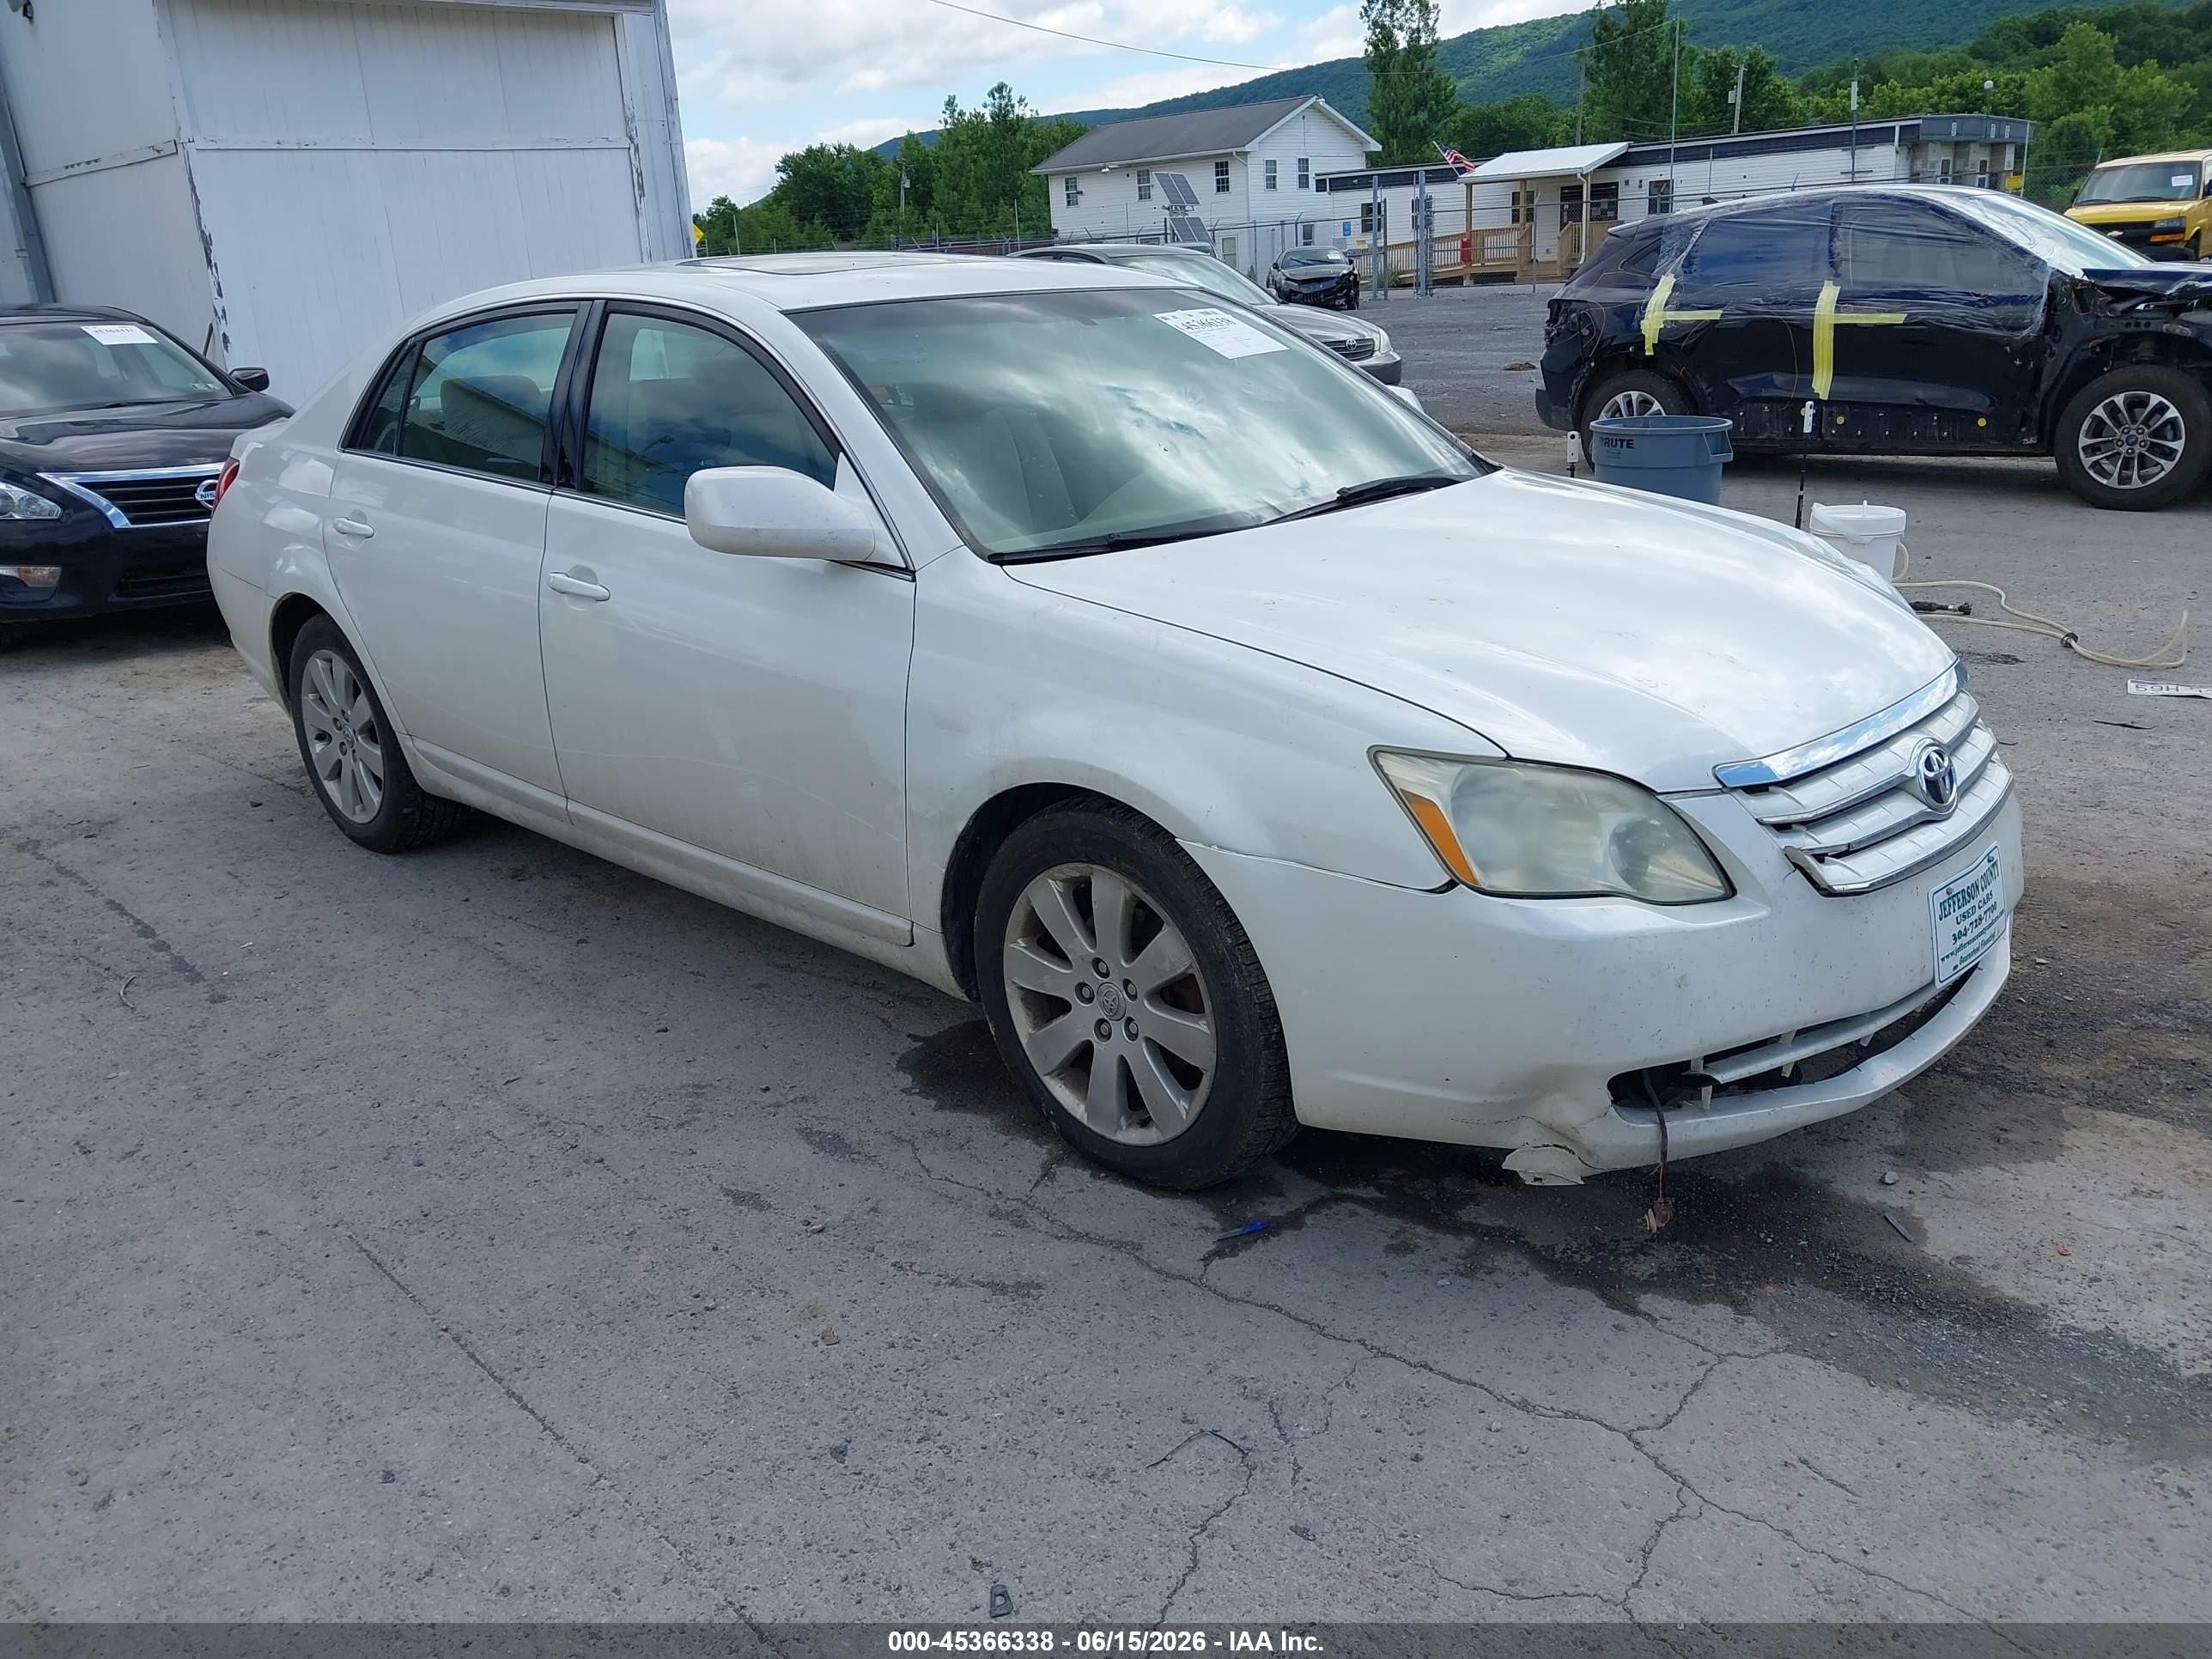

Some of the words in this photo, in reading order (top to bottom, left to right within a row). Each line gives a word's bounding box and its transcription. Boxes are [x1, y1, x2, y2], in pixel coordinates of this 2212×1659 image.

[1939, 878, 1980, 921] JEFFERSON
[1980, 859, 2000, 892] COUNTY
[1955, 905, 1977, 925] USED
[1978, 890, 1993, 910] CARS
[1952, 901, 1997, 945] 304-728-7700
